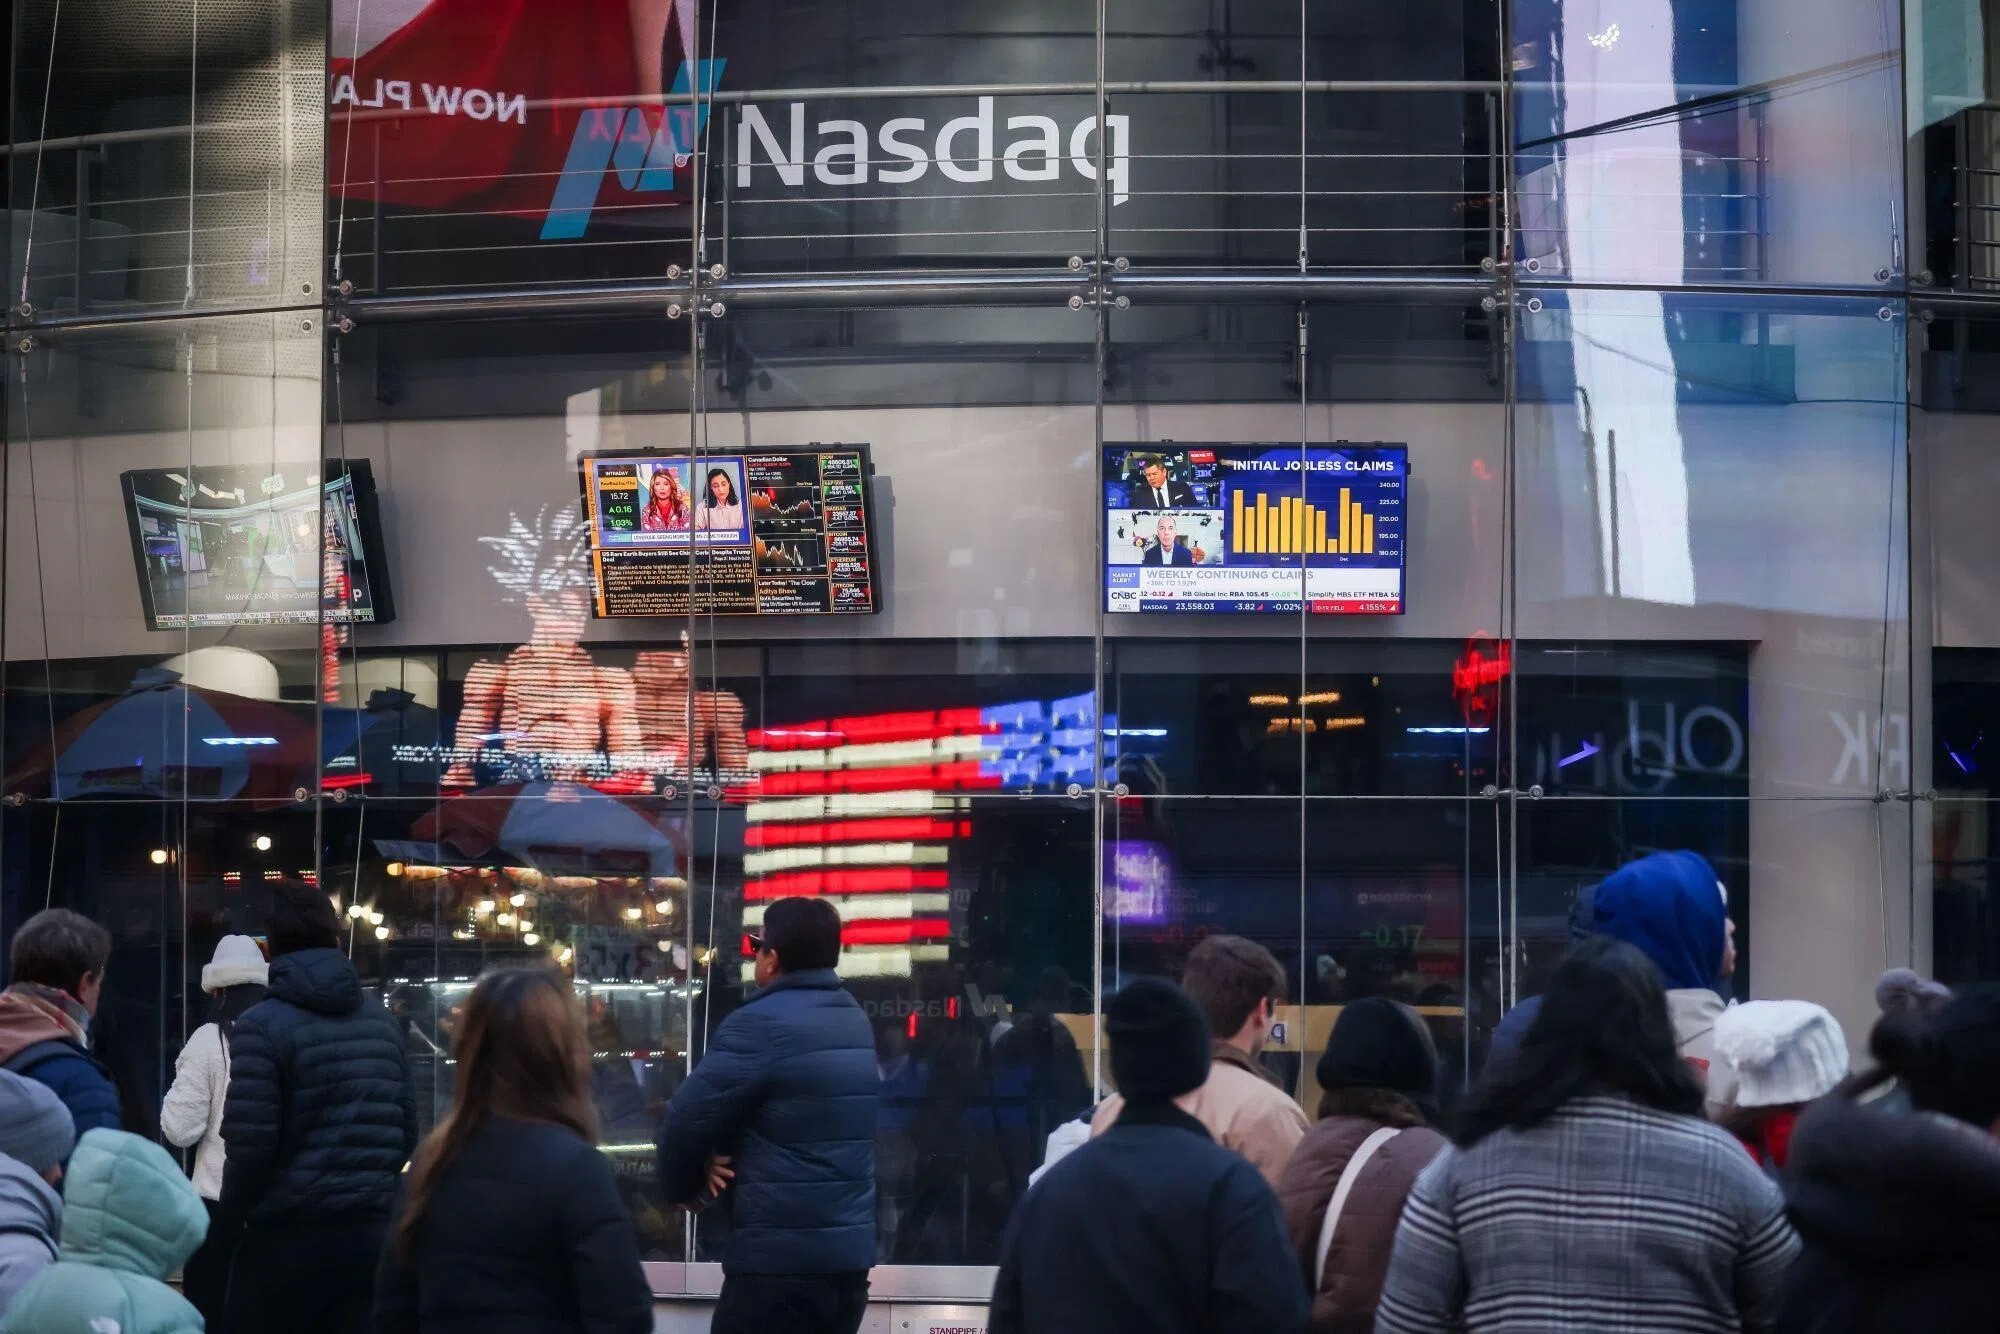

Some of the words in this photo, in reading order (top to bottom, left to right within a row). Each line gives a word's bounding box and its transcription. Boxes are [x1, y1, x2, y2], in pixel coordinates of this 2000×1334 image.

[737, 95, 1130, 207] Nasdaq
[1233, 461, 1280, 470] INITIAL
[1284, 460, 1341, 471] JOBLESS
[1345, 460, 1394, 471] CLAIMS
[1147, 570, 1193, 578] WEEKLY
[1196, 570, 1268, 579] CONTINUING
